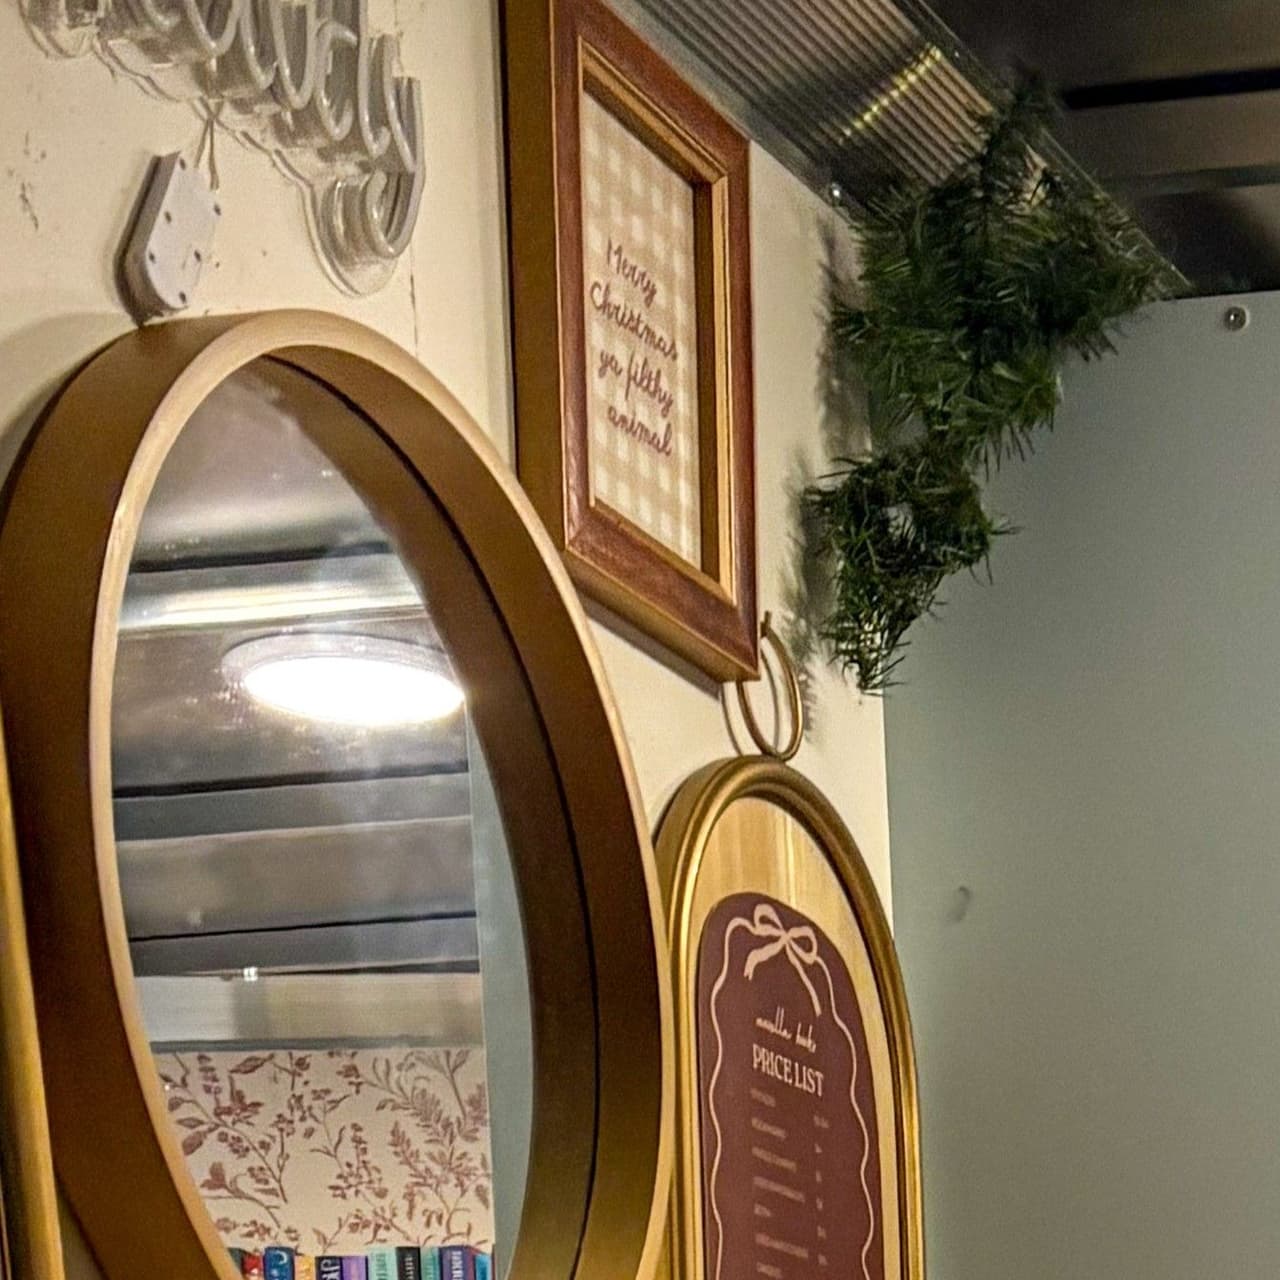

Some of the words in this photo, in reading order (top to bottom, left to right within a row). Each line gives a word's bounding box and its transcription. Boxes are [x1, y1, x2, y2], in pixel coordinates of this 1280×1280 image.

[607, 238, 658, 308] Merry
[589, 281, 678, 361] Christmas
[624, 352, 675, 418] filthy
[752, 1042, 793, 1086] PRICE
[794, 1061, 824, 1098] LIST
